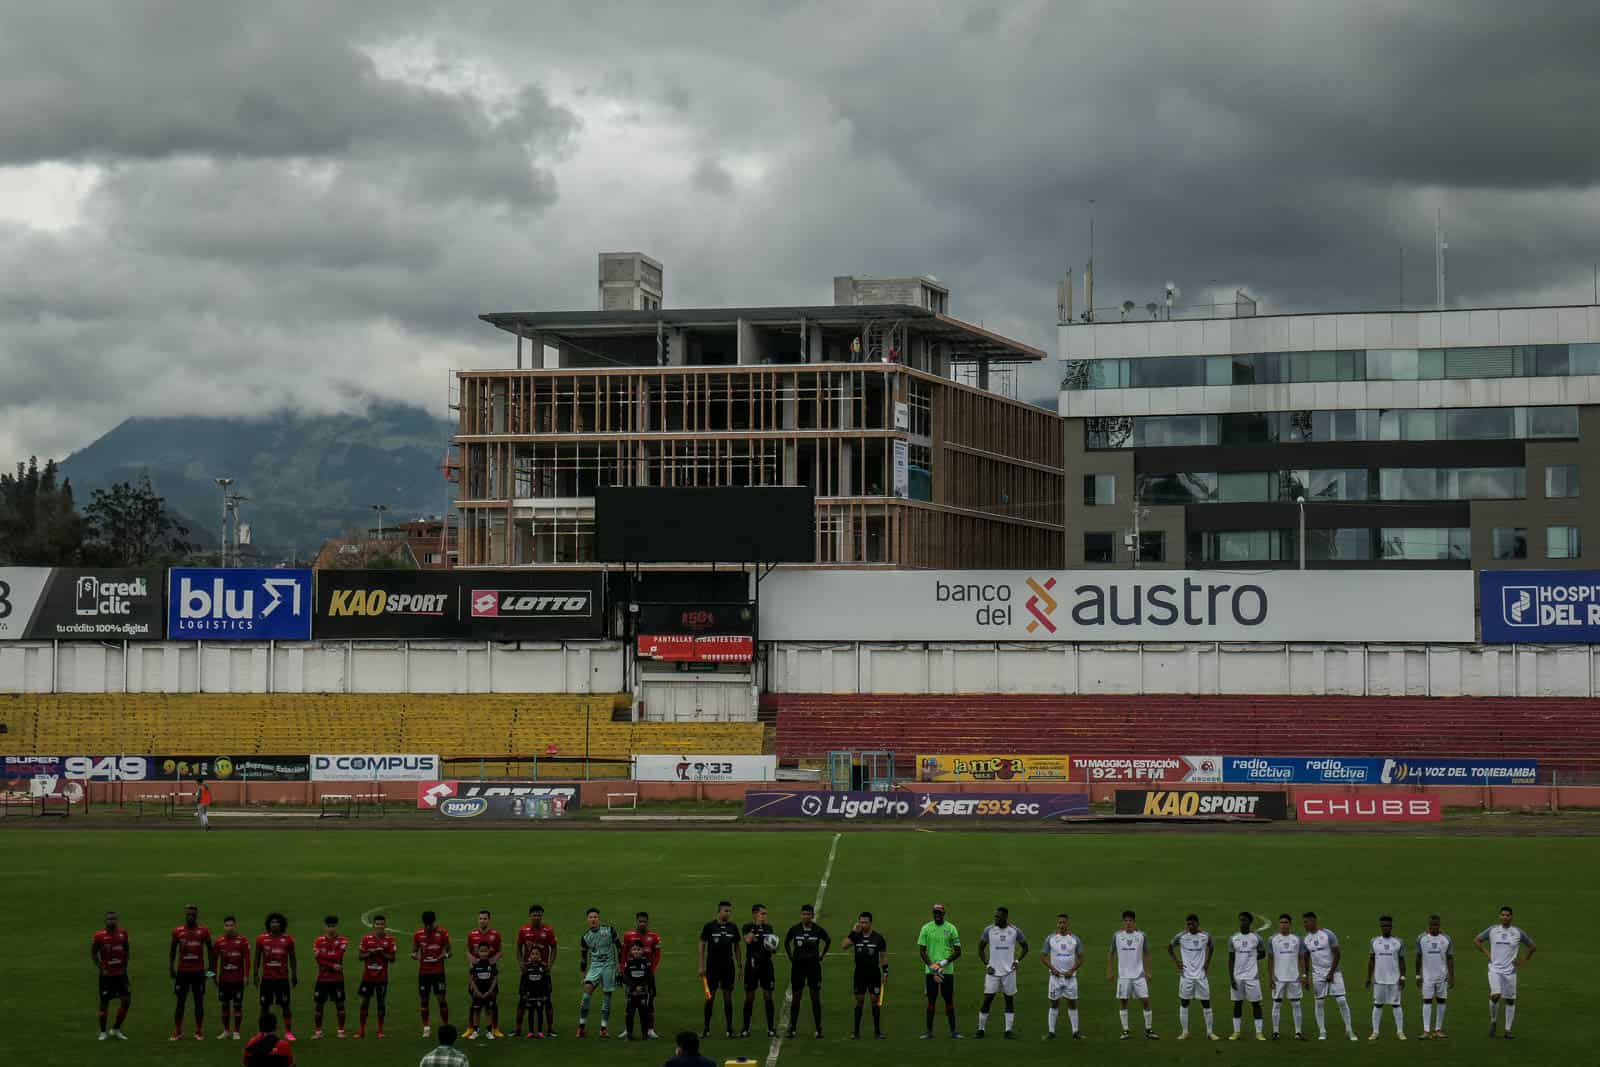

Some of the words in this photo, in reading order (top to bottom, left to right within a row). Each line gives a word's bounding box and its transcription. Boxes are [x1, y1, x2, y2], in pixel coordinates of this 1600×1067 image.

[100, 578, 147, 596] credi
[936, 581, 1012, 602] banco
[180, 578, 253, 618] blu
[328, 590, 386, 616] KAO
[386, 594, 448, 612] SPORT
[501, 597, 588, 611] LOTTO
[1071, 577, 1268, 626] austro
[100, 596, 130, 615] clic
[975, 604, 1012, 626] del
[1540, 604, 1582, 626] DEL
[56, 624, 66, 632] tu
[67, 623, 95, 632] crédito
[96, 624, 121, 632] 100%
[122, 623, 149, 634] digital
[179, 620, 254, 629] LOGISTICS
[336, 757, 434, 770] COMPUS
[1074, 760, 1086, 769] TU
[1087, 760, 1132, 769] MAGGICA
[1132, 758, 1179, 769] ESTACIÓN
[1233, 759, 1268, 769] radio
[1306, 759, 1341, 769] radio
[1093, 769, 1132, 779] 92.1
[1134, 769, 1164, 779] FM
[1250, 768, 1292, 778] activa
[1324, 768, 1365, 779] activa
[1409, 769, 1421, 777] LA
[1425, 768, 1447, 777] VOZ
[1448, 768, 1467, 777] DEL
[1470, 769, 1536, 778] TOMEBAMBA
[828, 796, 909, 818] LigaPro
[1143, 792, 1199, 817] KAO
[1199, 796, 1258, 813] SPORT
[1303, 800, 1431, 815] CHUBB
